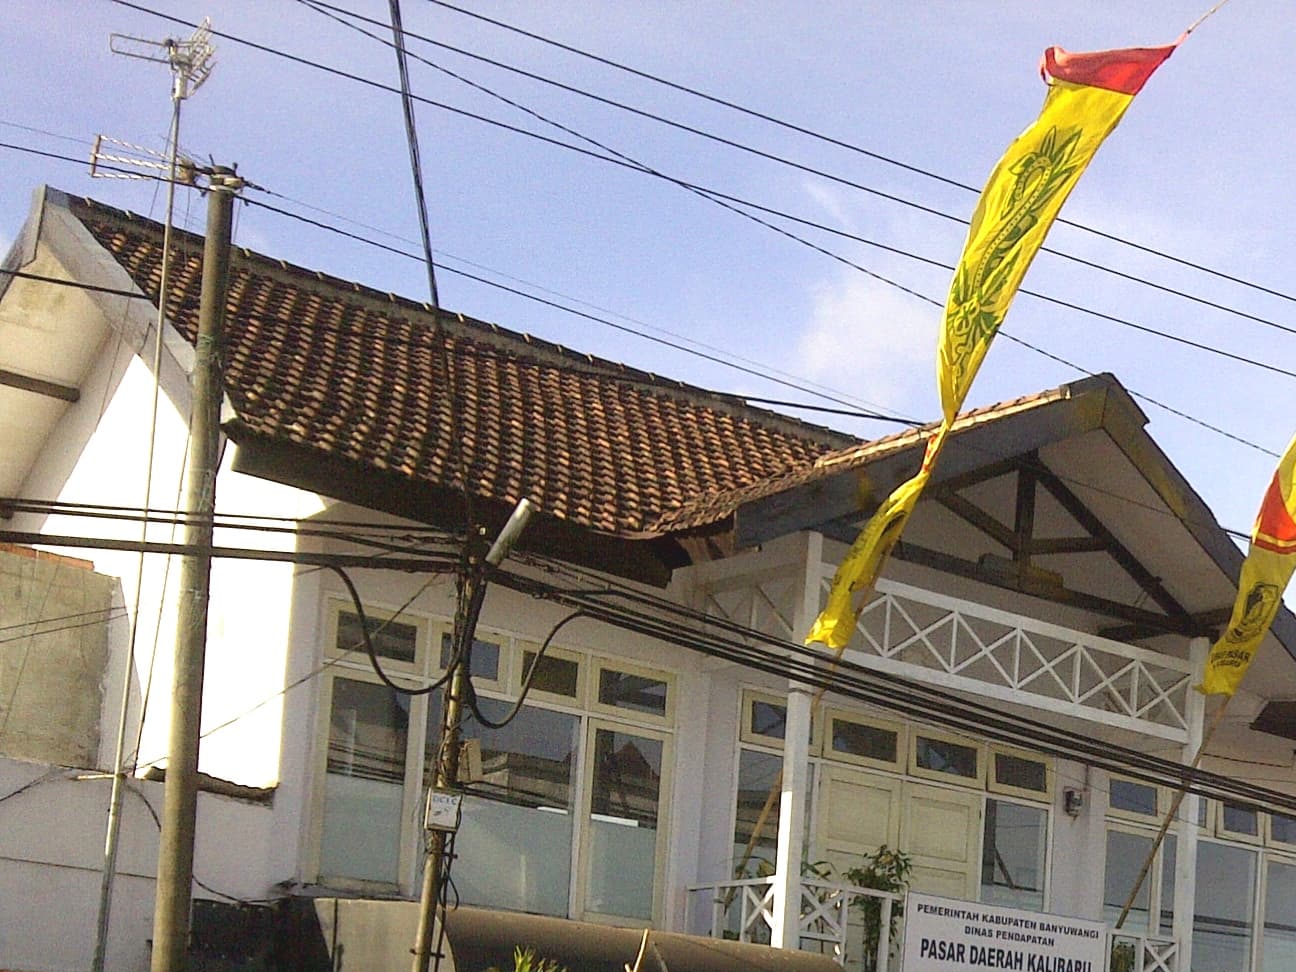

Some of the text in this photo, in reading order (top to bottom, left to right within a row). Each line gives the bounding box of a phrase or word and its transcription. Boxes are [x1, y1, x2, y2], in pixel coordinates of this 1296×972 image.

[917, 903, 1099, 939] PEMERINTAH KABUPATEN BANYUWANGI
[964, 925, 1055, 947] DINAS PENDAPATAN
[920, 938, 965, 963] PASAR
[969, 945, 1023, 971] DAERAH
